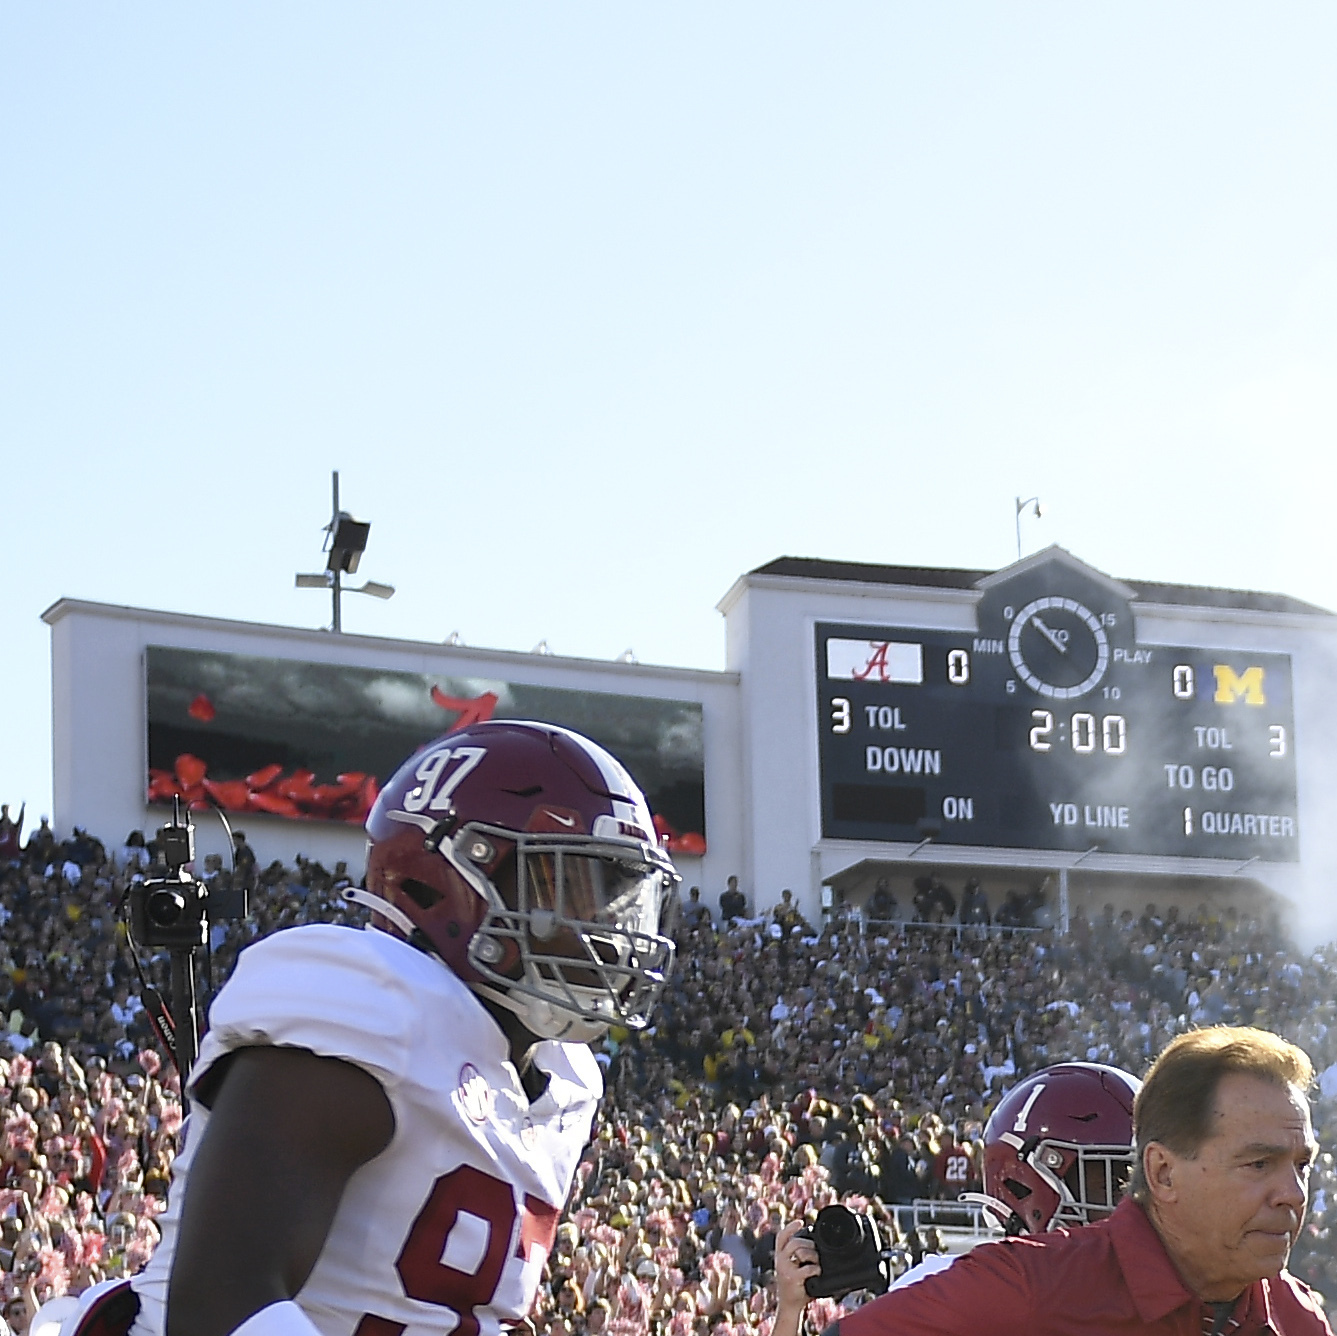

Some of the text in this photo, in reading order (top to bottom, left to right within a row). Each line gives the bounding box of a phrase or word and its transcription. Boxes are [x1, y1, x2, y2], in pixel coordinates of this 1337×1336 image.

[1004, 606, 1013, 620] 0
[1100, 614, 1115, 626] 15
[973, 638, 1003, 654] MIN
[1114, 648, 1151, 664] PLAY
[948, 649, 970, 684] 0
[1006, 680, 1016, 693] 5
[1103, 687, 1121, 700] 10
[1173, 664, 1265, 705] 0 M
[831, 697, 906, 734] 3 TOL
[1030, 710, 1126, 754] 2:00
[1194, 724, 1286, 757] TOL 3
[866, 746, 942, 775] DOWN
[403, 746, 487, 812] 97
[1164, 764, 1234, 792] TO GO
[943, 796, 974, 820] ON
[1049, 803, 1130, 829] YD LINE
[1184, 806, 1294, 837] 1 QUARTER
[1014, 1084, 1046, 1132] 1
[945, 1156, 968, 1180] 22
